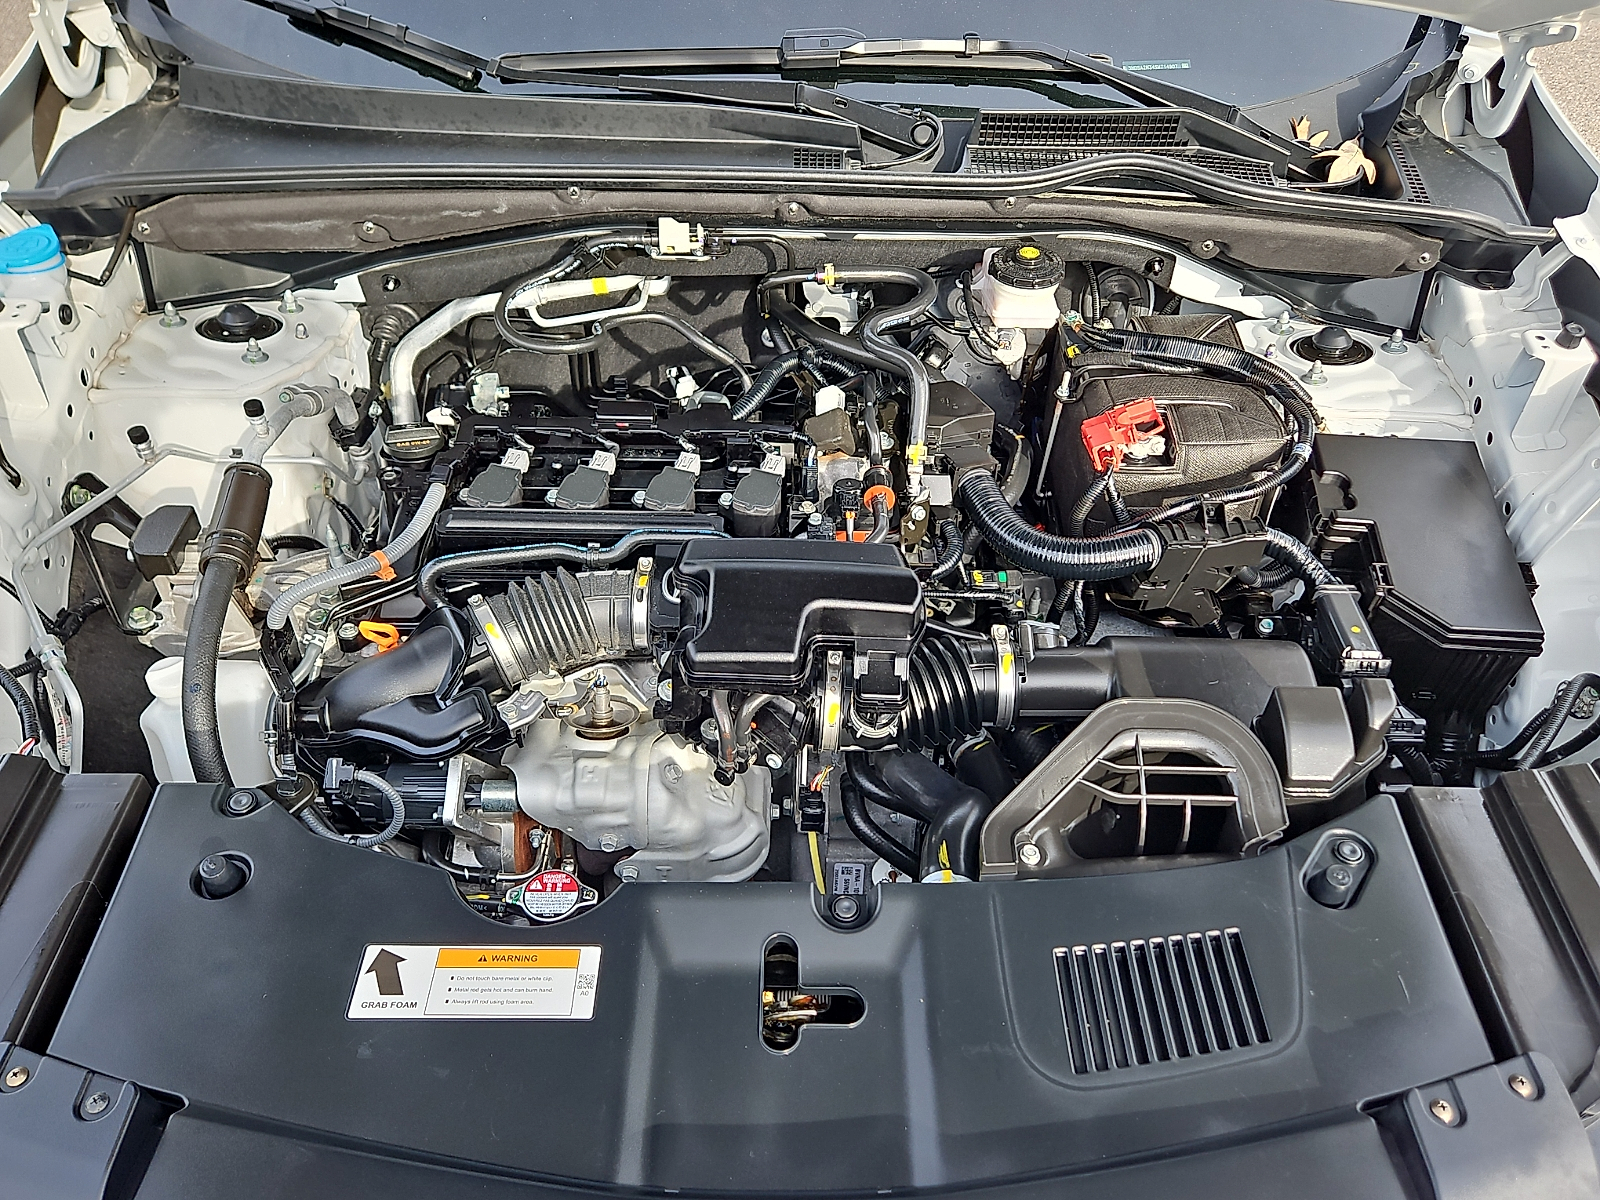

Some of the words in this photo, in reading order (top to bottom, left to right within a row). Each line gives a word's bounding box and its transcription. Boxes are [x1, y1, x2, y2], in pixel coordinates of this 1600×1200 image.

[491, 954, 538, 963] WARNING
[480, 986, 492, 995] gets
[451, 998, 471, 1007] Always
[471, 998, 479, 1006] lift
[479, 998, 489, 1006] rod
[490, 998, 504, 1007] using
[505, 998, 520, 1006] foam
